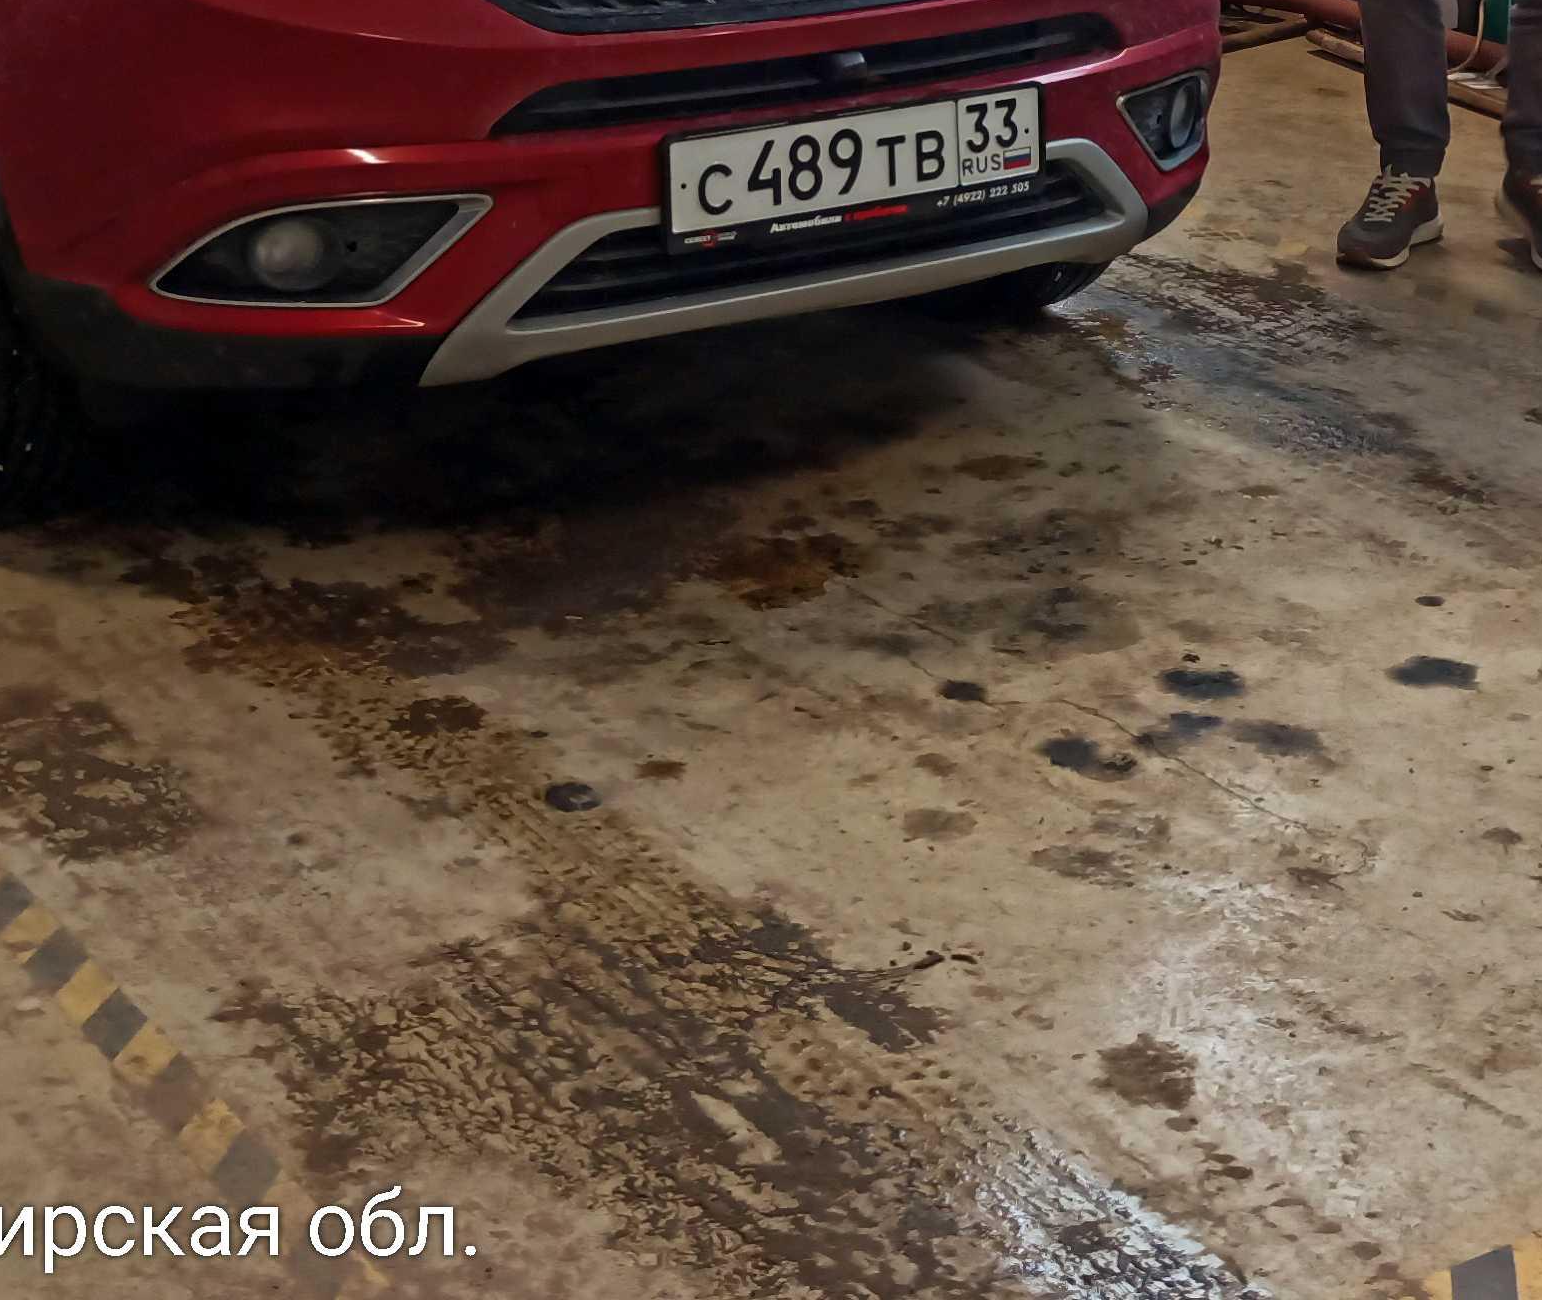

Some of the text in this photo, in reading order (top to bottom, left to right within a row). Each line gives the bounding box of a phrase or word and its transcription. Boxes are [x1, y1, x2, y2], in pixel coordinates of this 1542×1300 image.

[698, 98, 1018, 215] С489ТВ 33
[962, 154, 1002, 177] RUS
